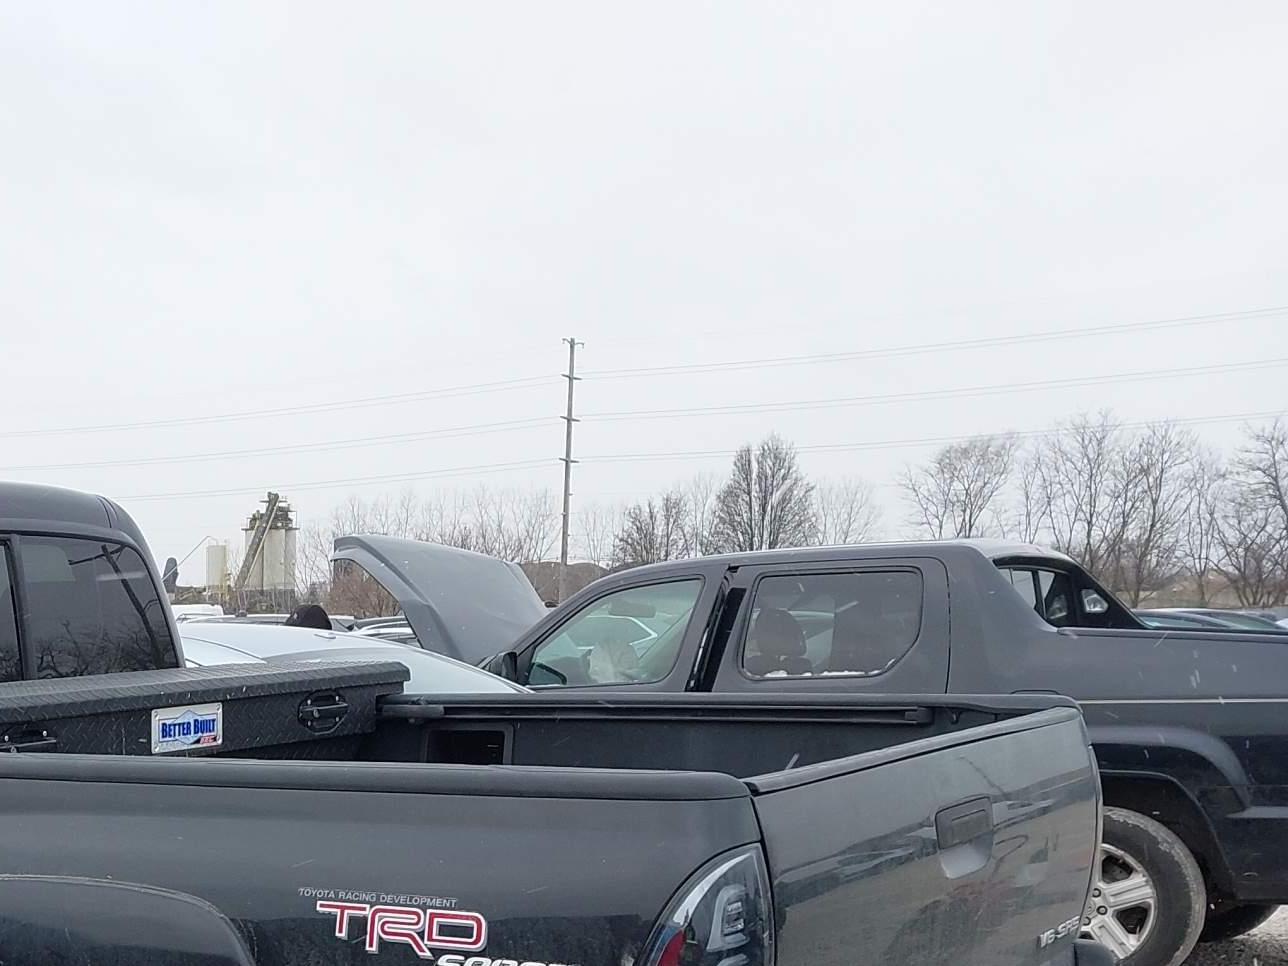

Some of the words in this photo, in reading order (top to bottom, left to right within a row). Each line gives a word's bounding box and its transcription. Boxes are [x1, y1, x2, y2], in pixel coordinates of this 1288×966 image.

[161, 722, 192, 739] BETTER
[193, 718, 217, 735] BUILT
[297, 887, 336, 900] TOYOTA
[338, 890, 377, 903] RACING
[379, 894, 457, 909] DEVELOPMENT
[315, 899, 488, 960] TRD
